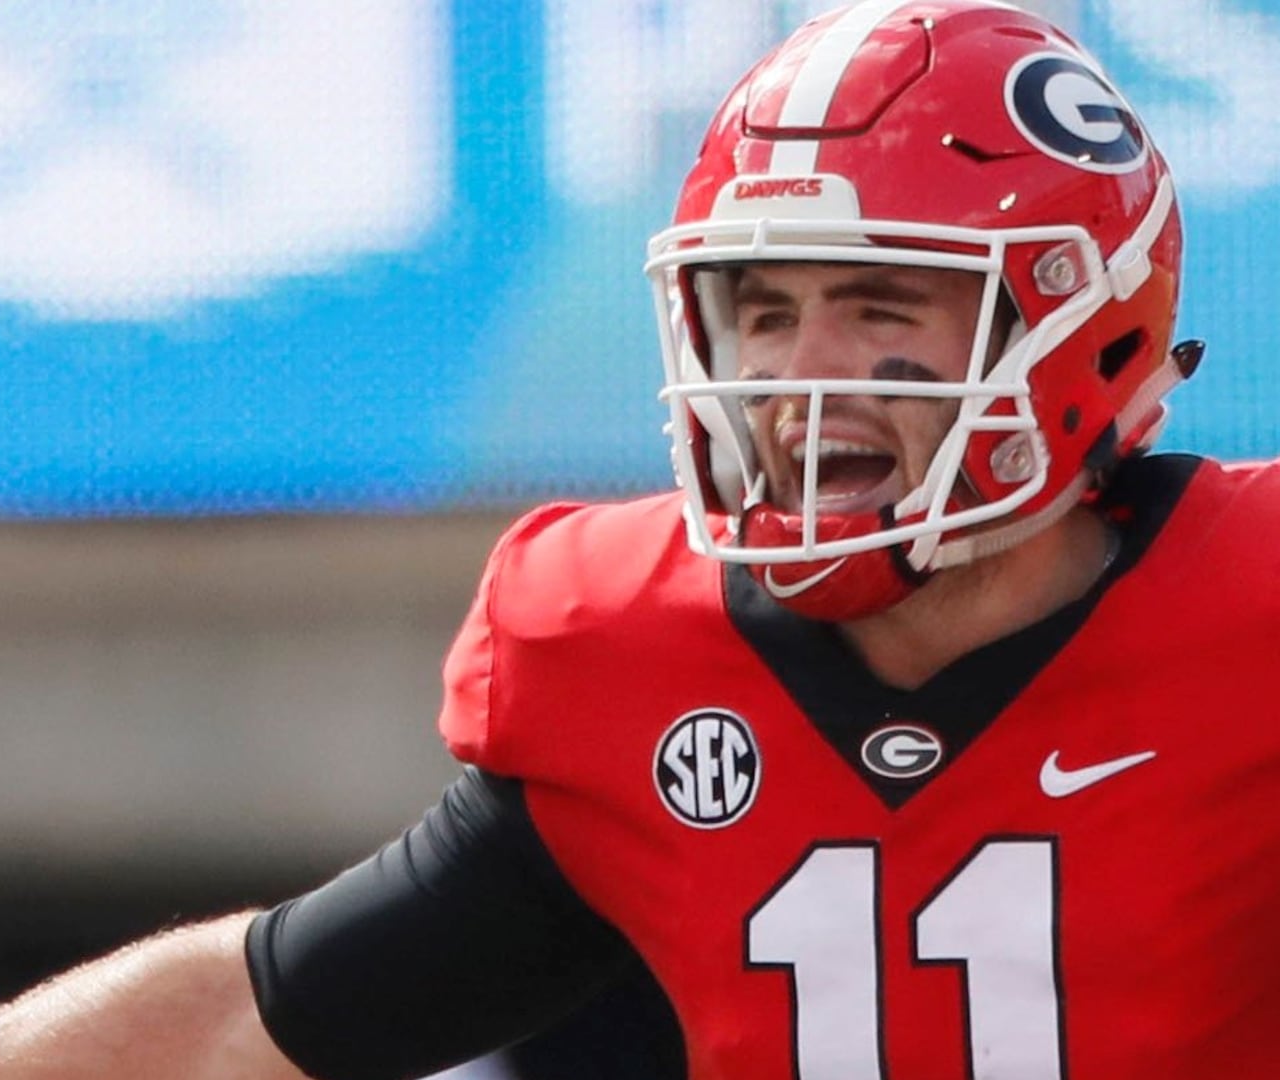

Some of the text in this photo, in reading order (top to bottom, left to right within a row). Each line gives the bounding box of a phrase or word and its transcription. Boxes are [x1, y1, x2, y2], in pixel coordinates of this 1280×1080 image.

[1020, 60, 1140, 162] G
[733, 178, 823, 200] DAWGS
[660, 714, 754, 820] SEC
[869, 729, 940, 774] G
